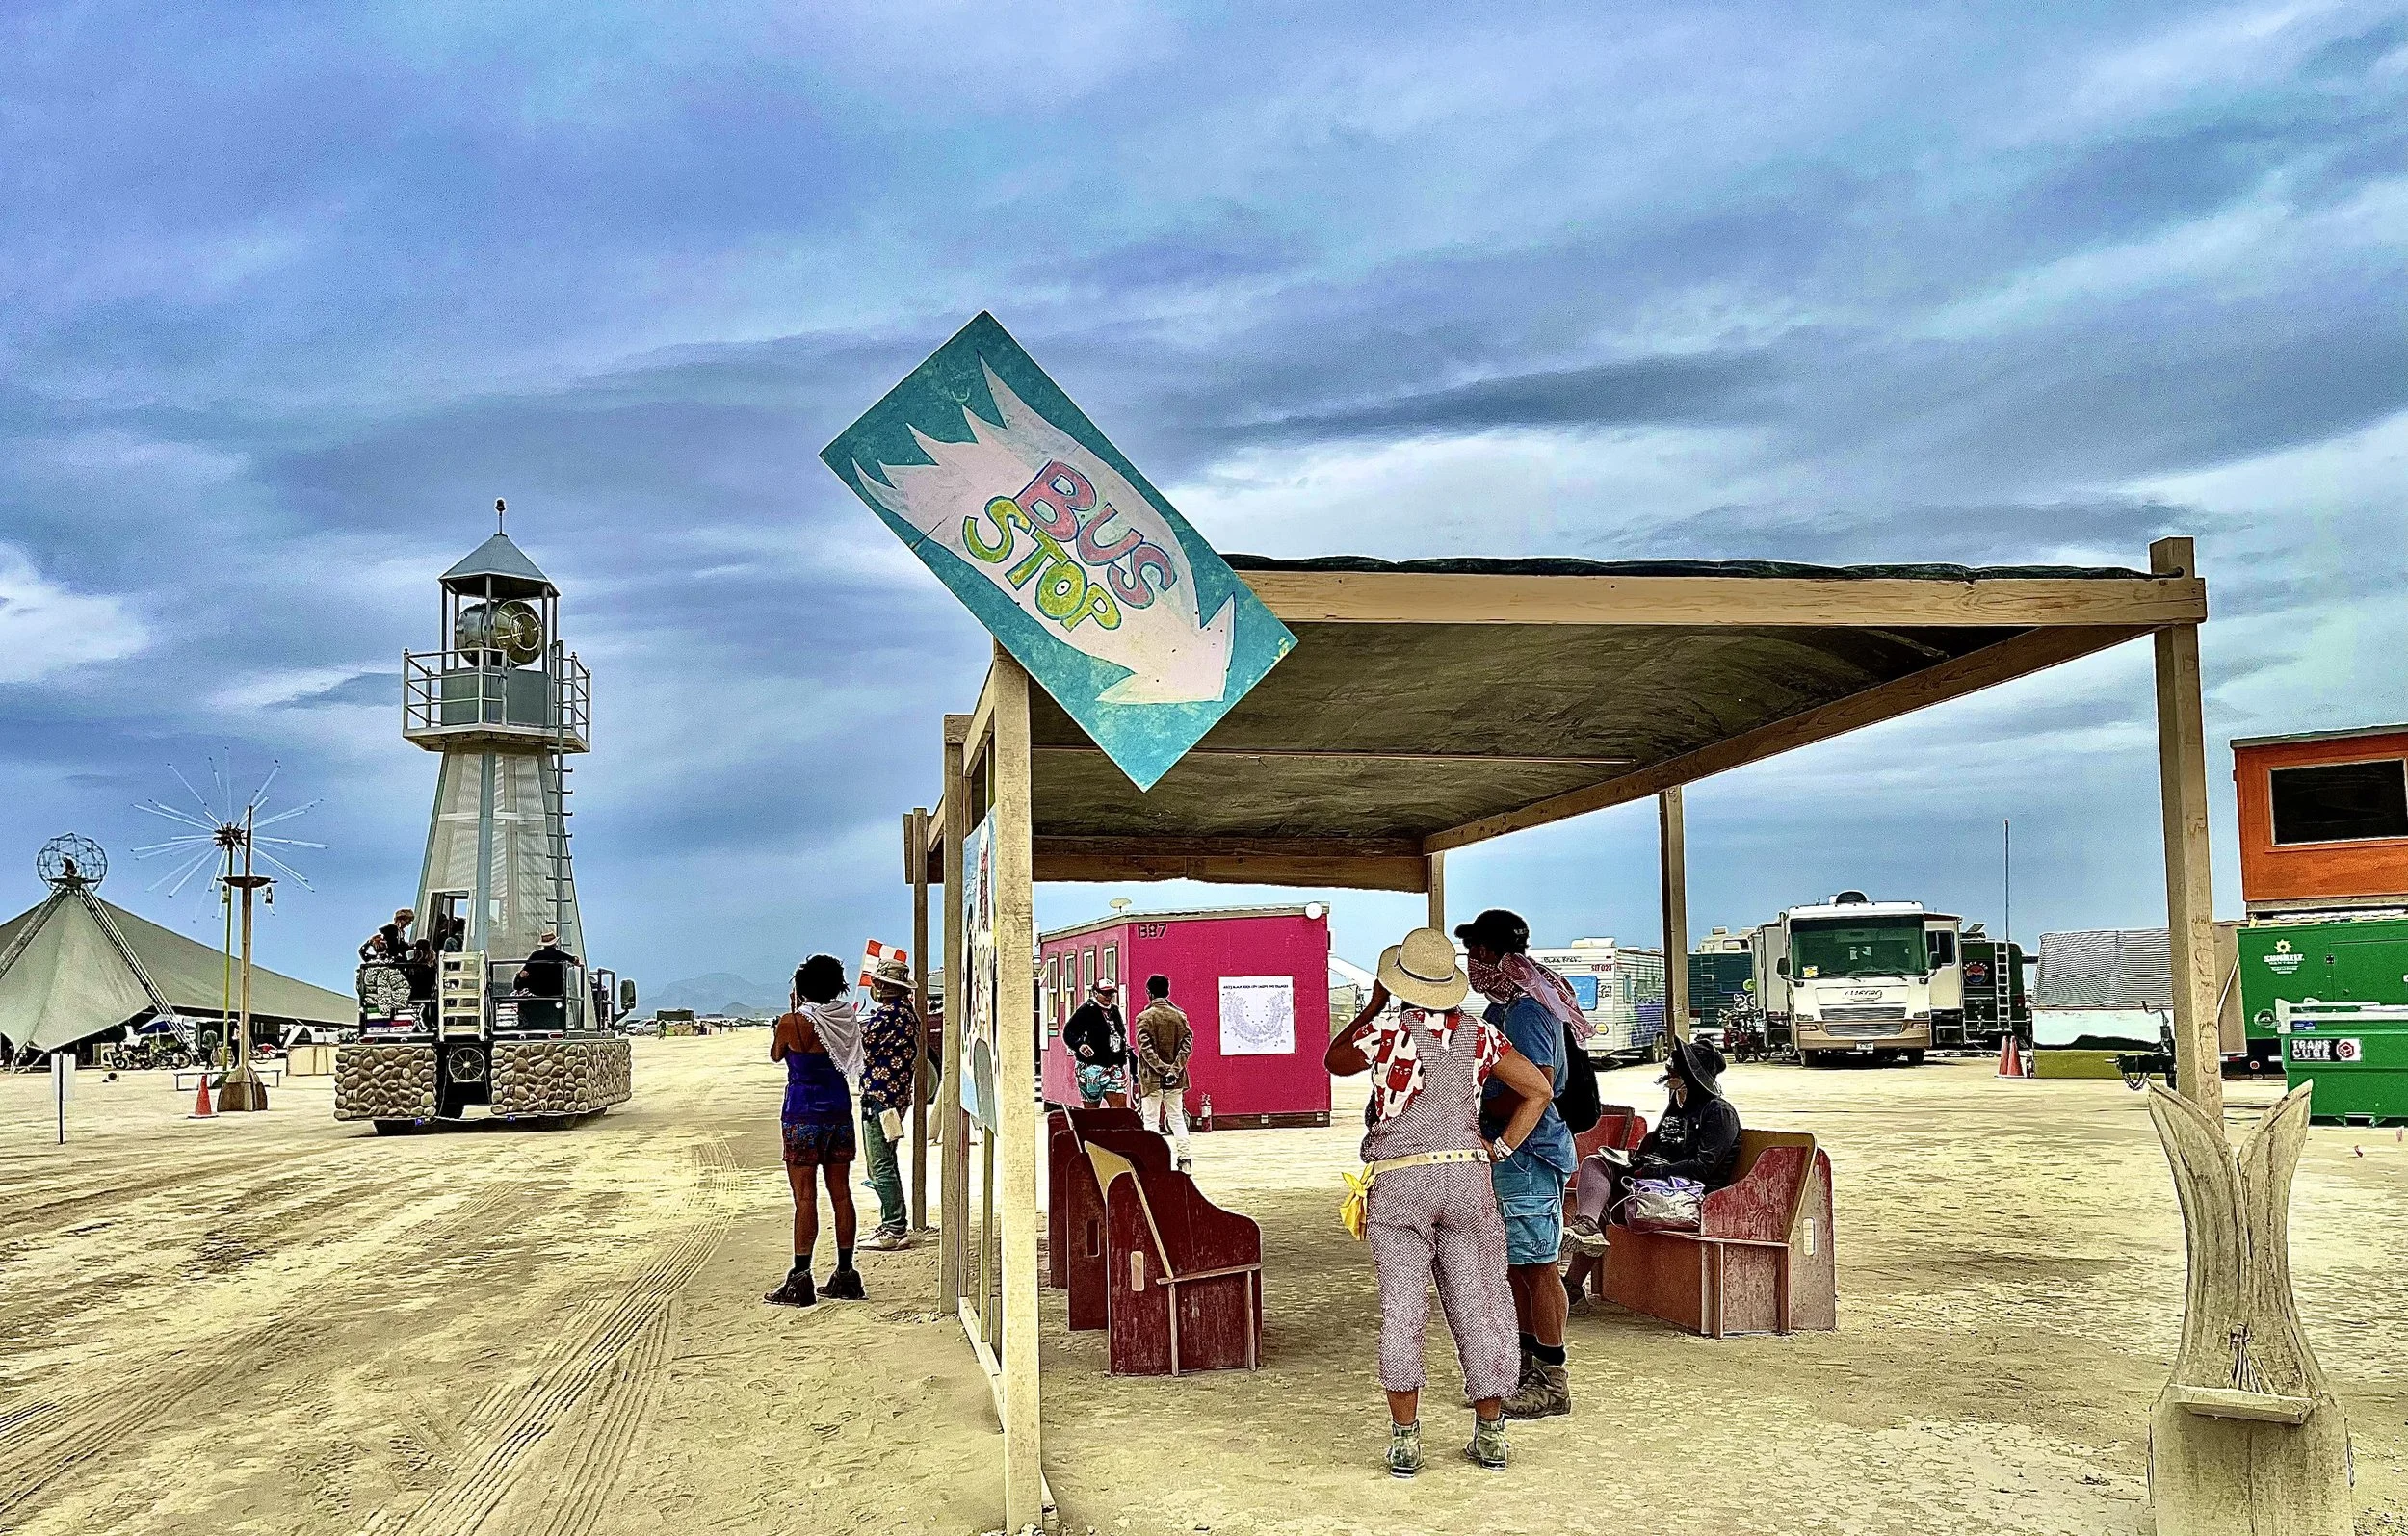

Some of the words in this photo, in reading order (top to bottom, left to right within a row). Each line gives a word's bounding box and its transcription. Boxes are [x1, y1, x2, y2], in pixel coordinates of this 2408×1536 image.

[1013, 459, 1177, 609] BUS
[962, 496, 1122, 632] STOP
[1138, 924, 1167, 939] B87
[2292, 1040, 2331, 1050] TRANS
[2292, 1049, 2331, 1059] CUBE
